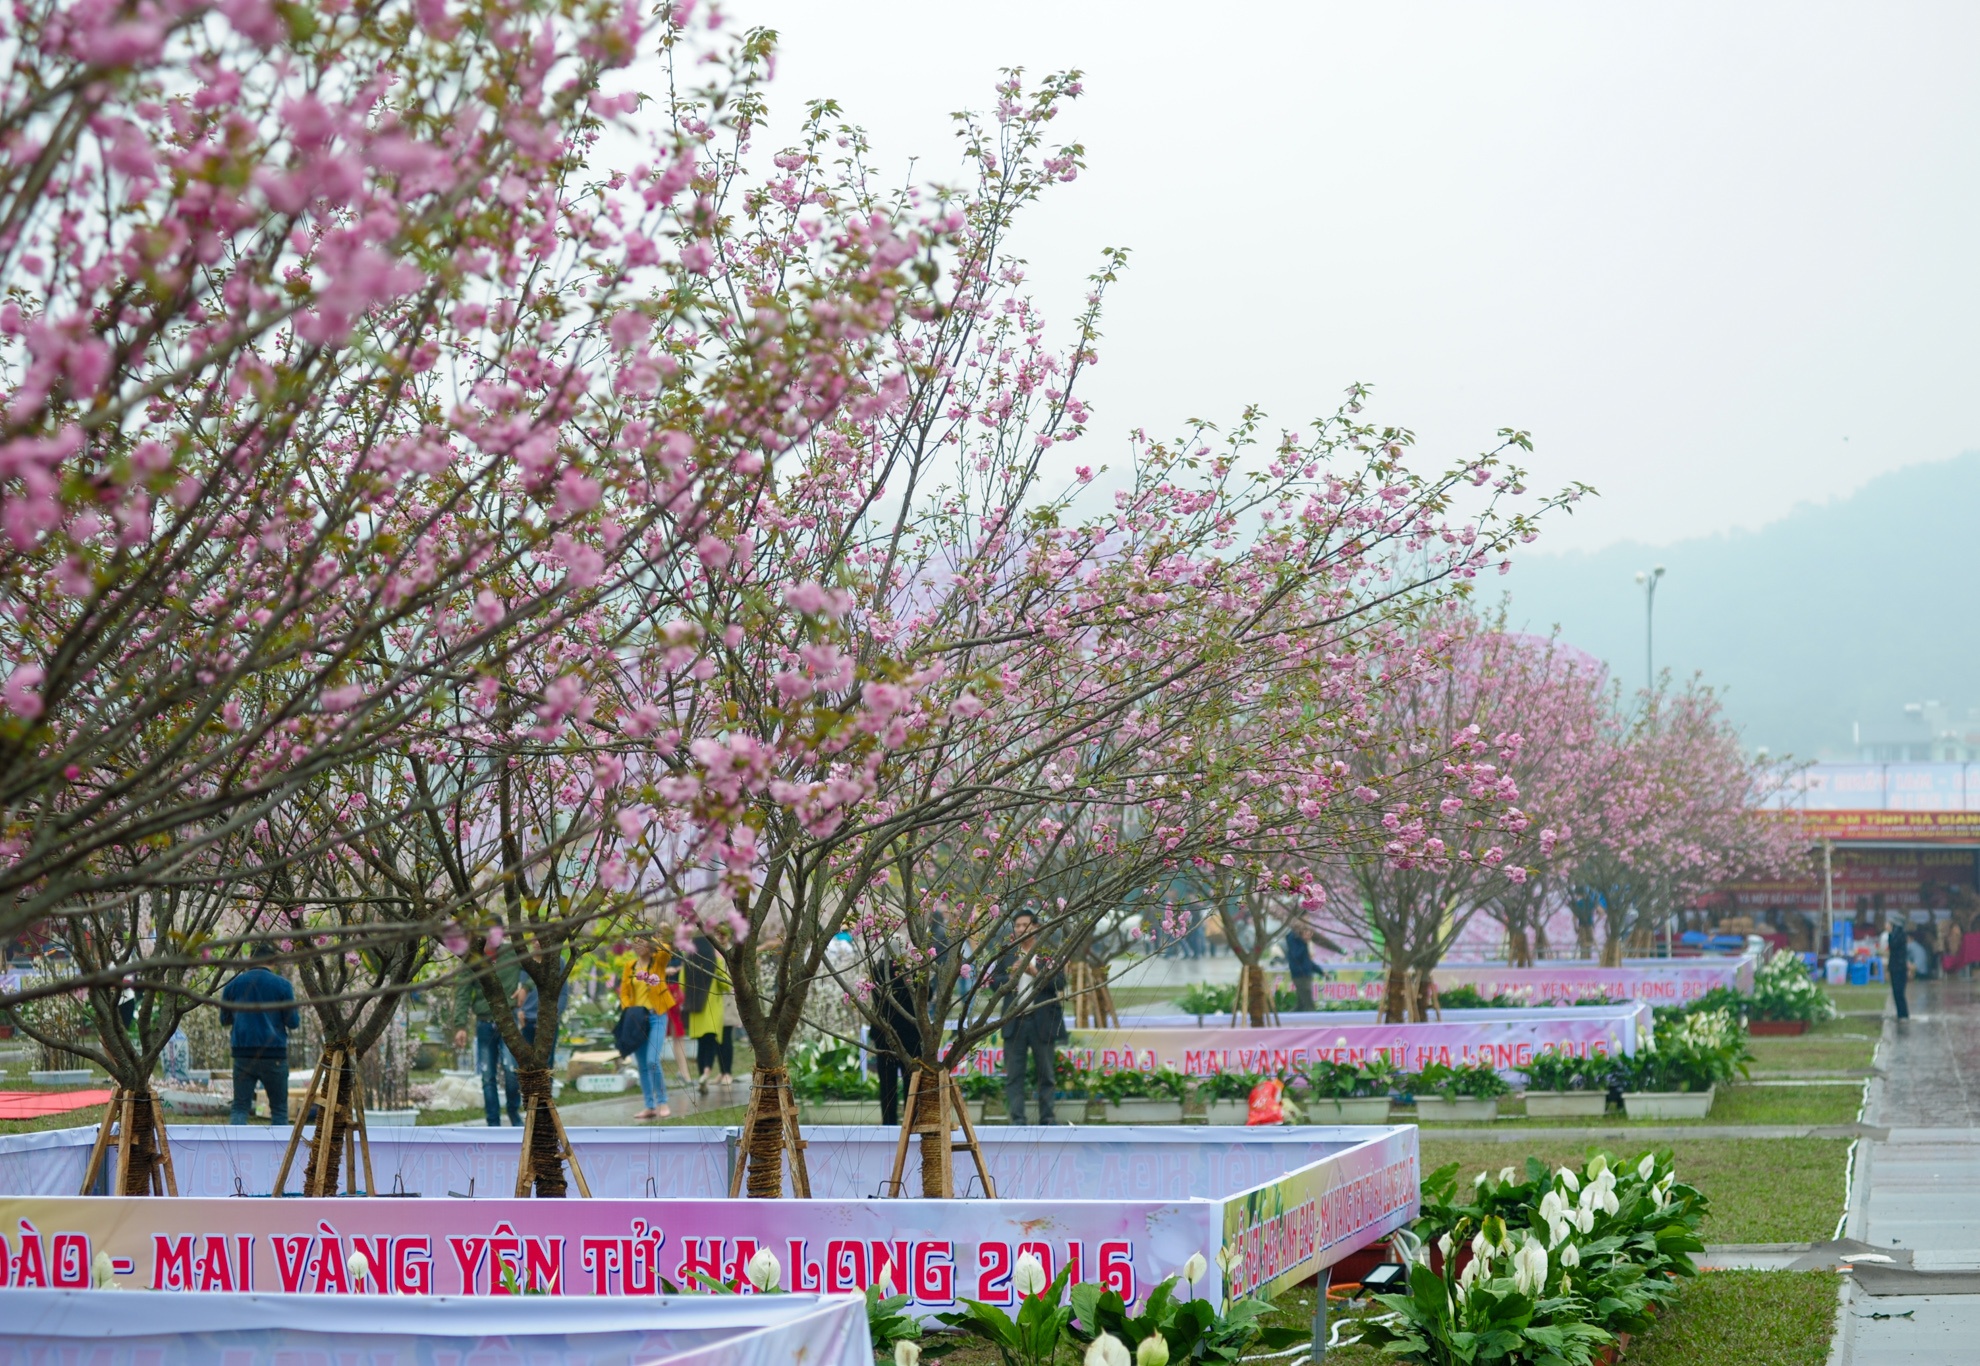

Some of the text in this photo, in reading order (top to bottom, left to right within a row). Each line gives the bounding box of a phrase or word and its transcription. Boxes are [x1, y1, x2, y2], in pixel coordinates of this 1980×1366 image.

[151, 1232, 257, 1294] MAI
[269, 1218, 433, 1296] VÀNG
[446, 1220, 567, 1297] YÊN
[580, 1217, 665, 1296] TỬ
[785, 1237, 957, 1306] LONG
[976, 1238, 1138, 1306] 2016
